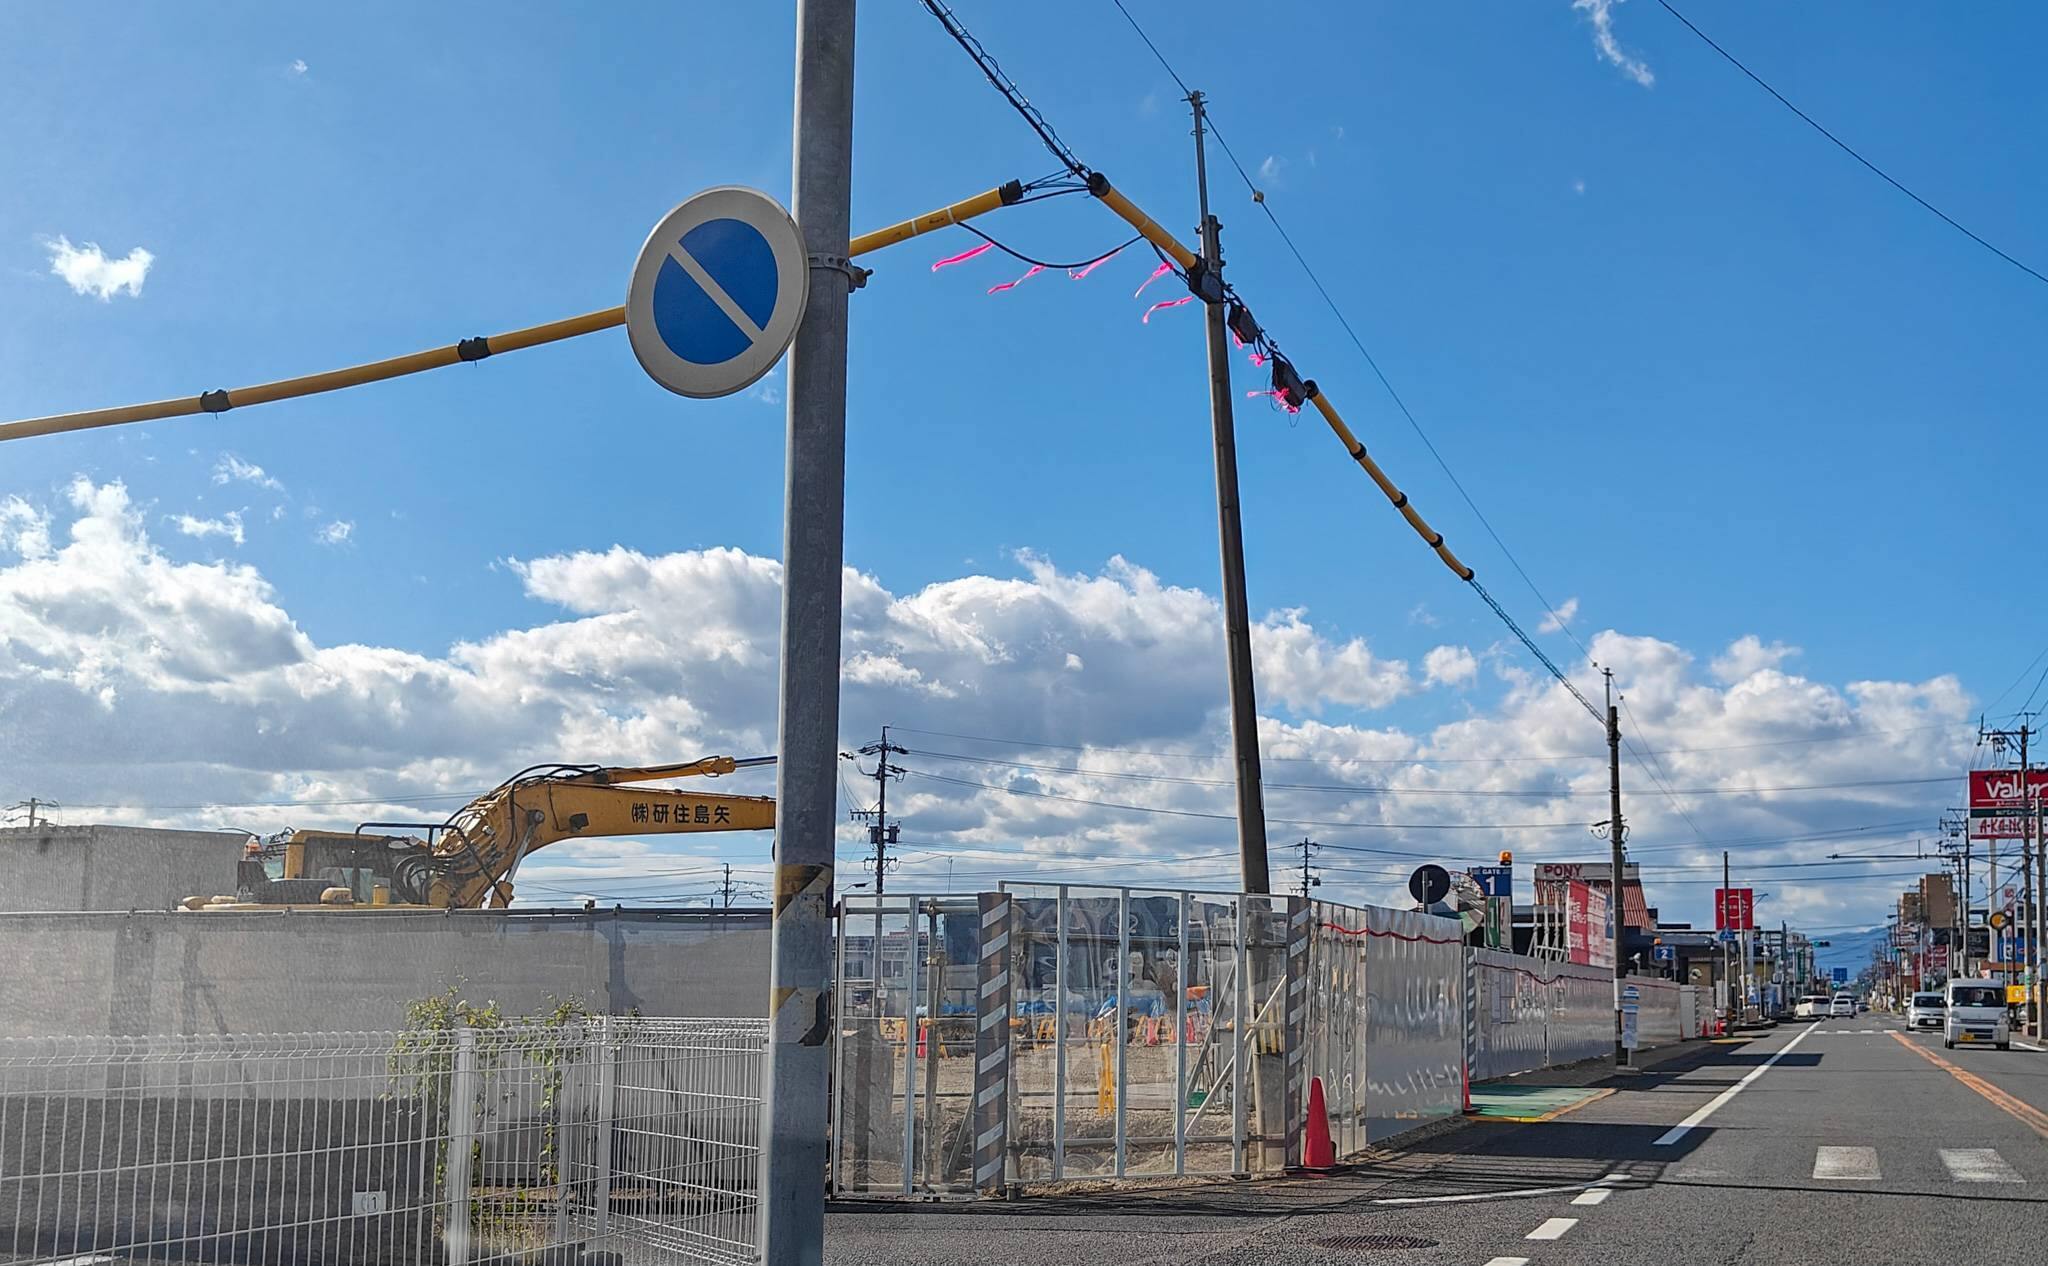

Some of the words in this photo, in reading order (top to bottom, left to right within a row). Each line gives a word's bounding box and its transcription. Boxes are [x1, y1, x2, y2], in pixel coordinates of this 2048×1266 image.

[1543, 864, 1582, 877] PONY
[1486, 876, 1496, 895] 1
[1660, 949, 1669, 959] 2
